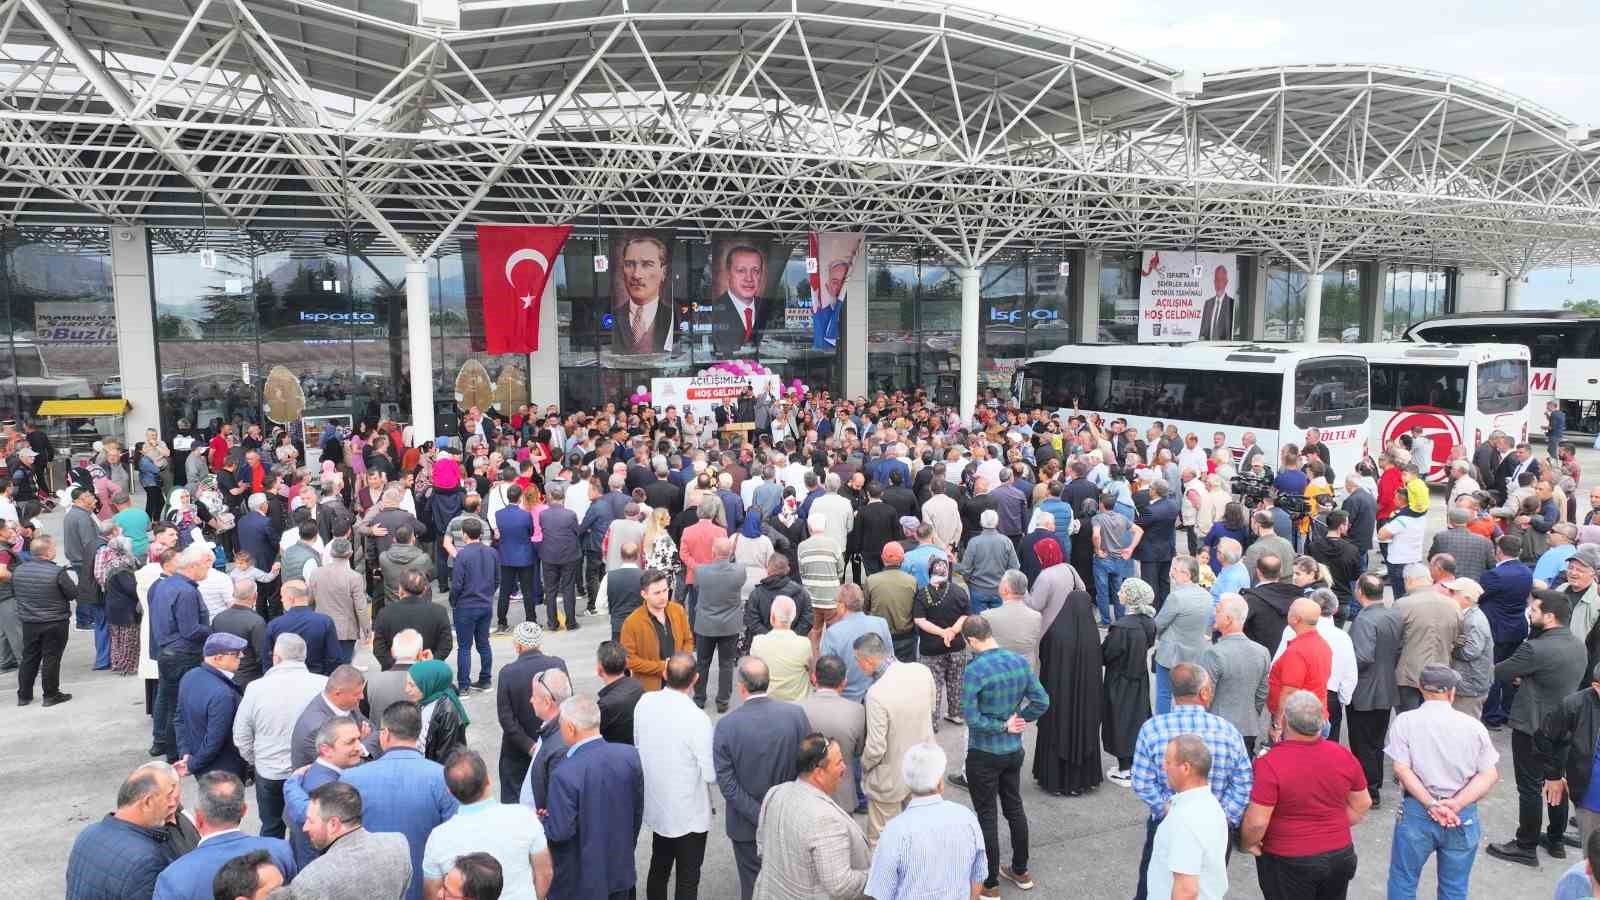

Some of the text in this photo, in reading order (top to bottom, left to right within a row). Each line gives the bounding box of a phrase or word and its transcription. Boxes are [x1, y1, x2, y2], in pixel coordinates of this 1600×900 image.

[1144, 310, 1164, 321] HOŞ
[694, 387, 743, 399] HOŞ GELDİN
